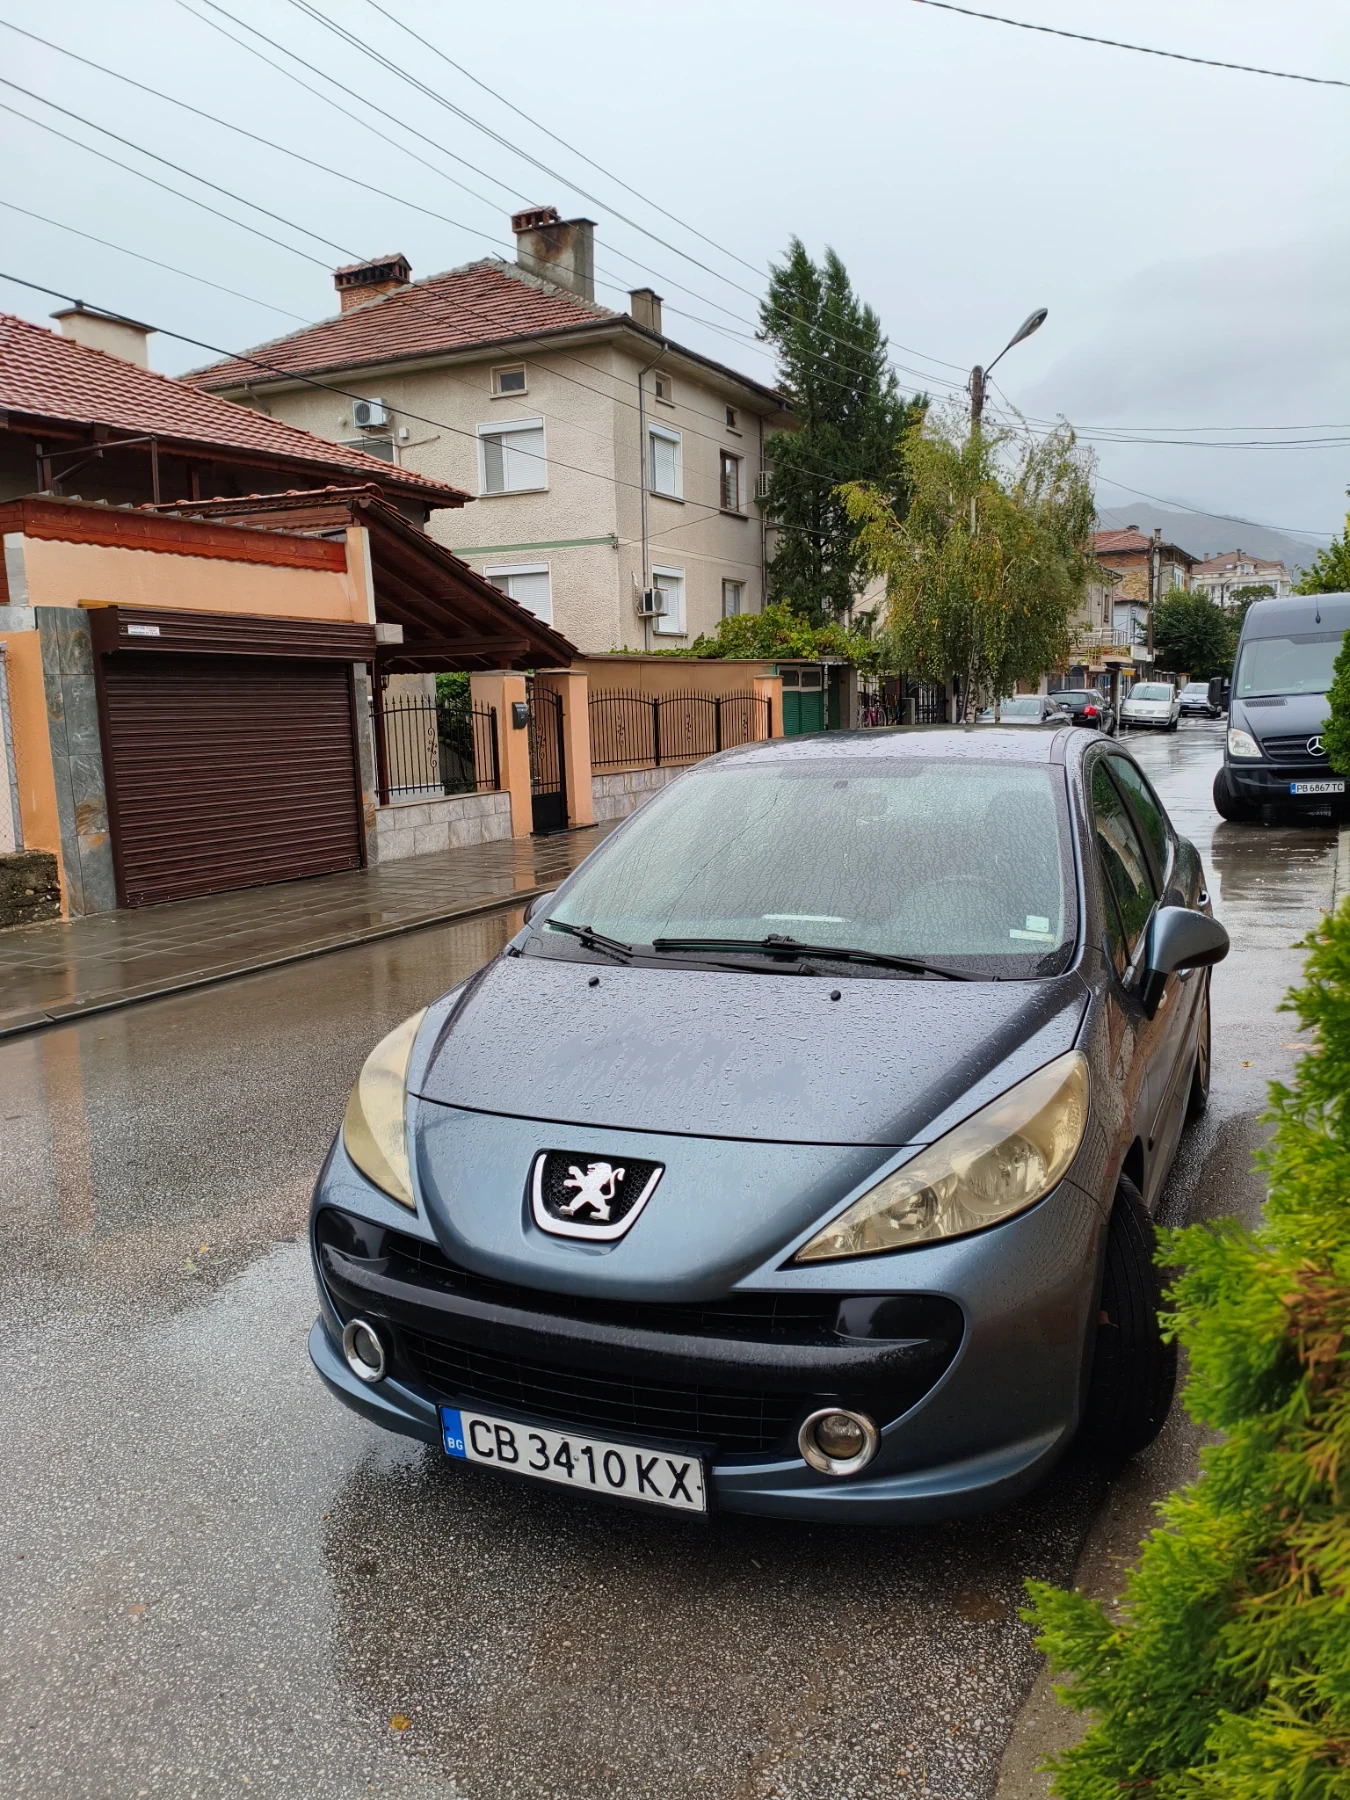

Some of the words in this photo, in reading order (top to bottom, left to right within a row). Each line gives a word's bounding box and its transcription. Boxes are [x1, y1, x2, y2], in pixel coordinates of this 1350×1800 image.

[447, 1437, 463, 1450] BG
[468, 1419, 519, 1464] CB
[528, 1433, 626, 1488] 3410
[635, 1453, 694, 1503] KX
